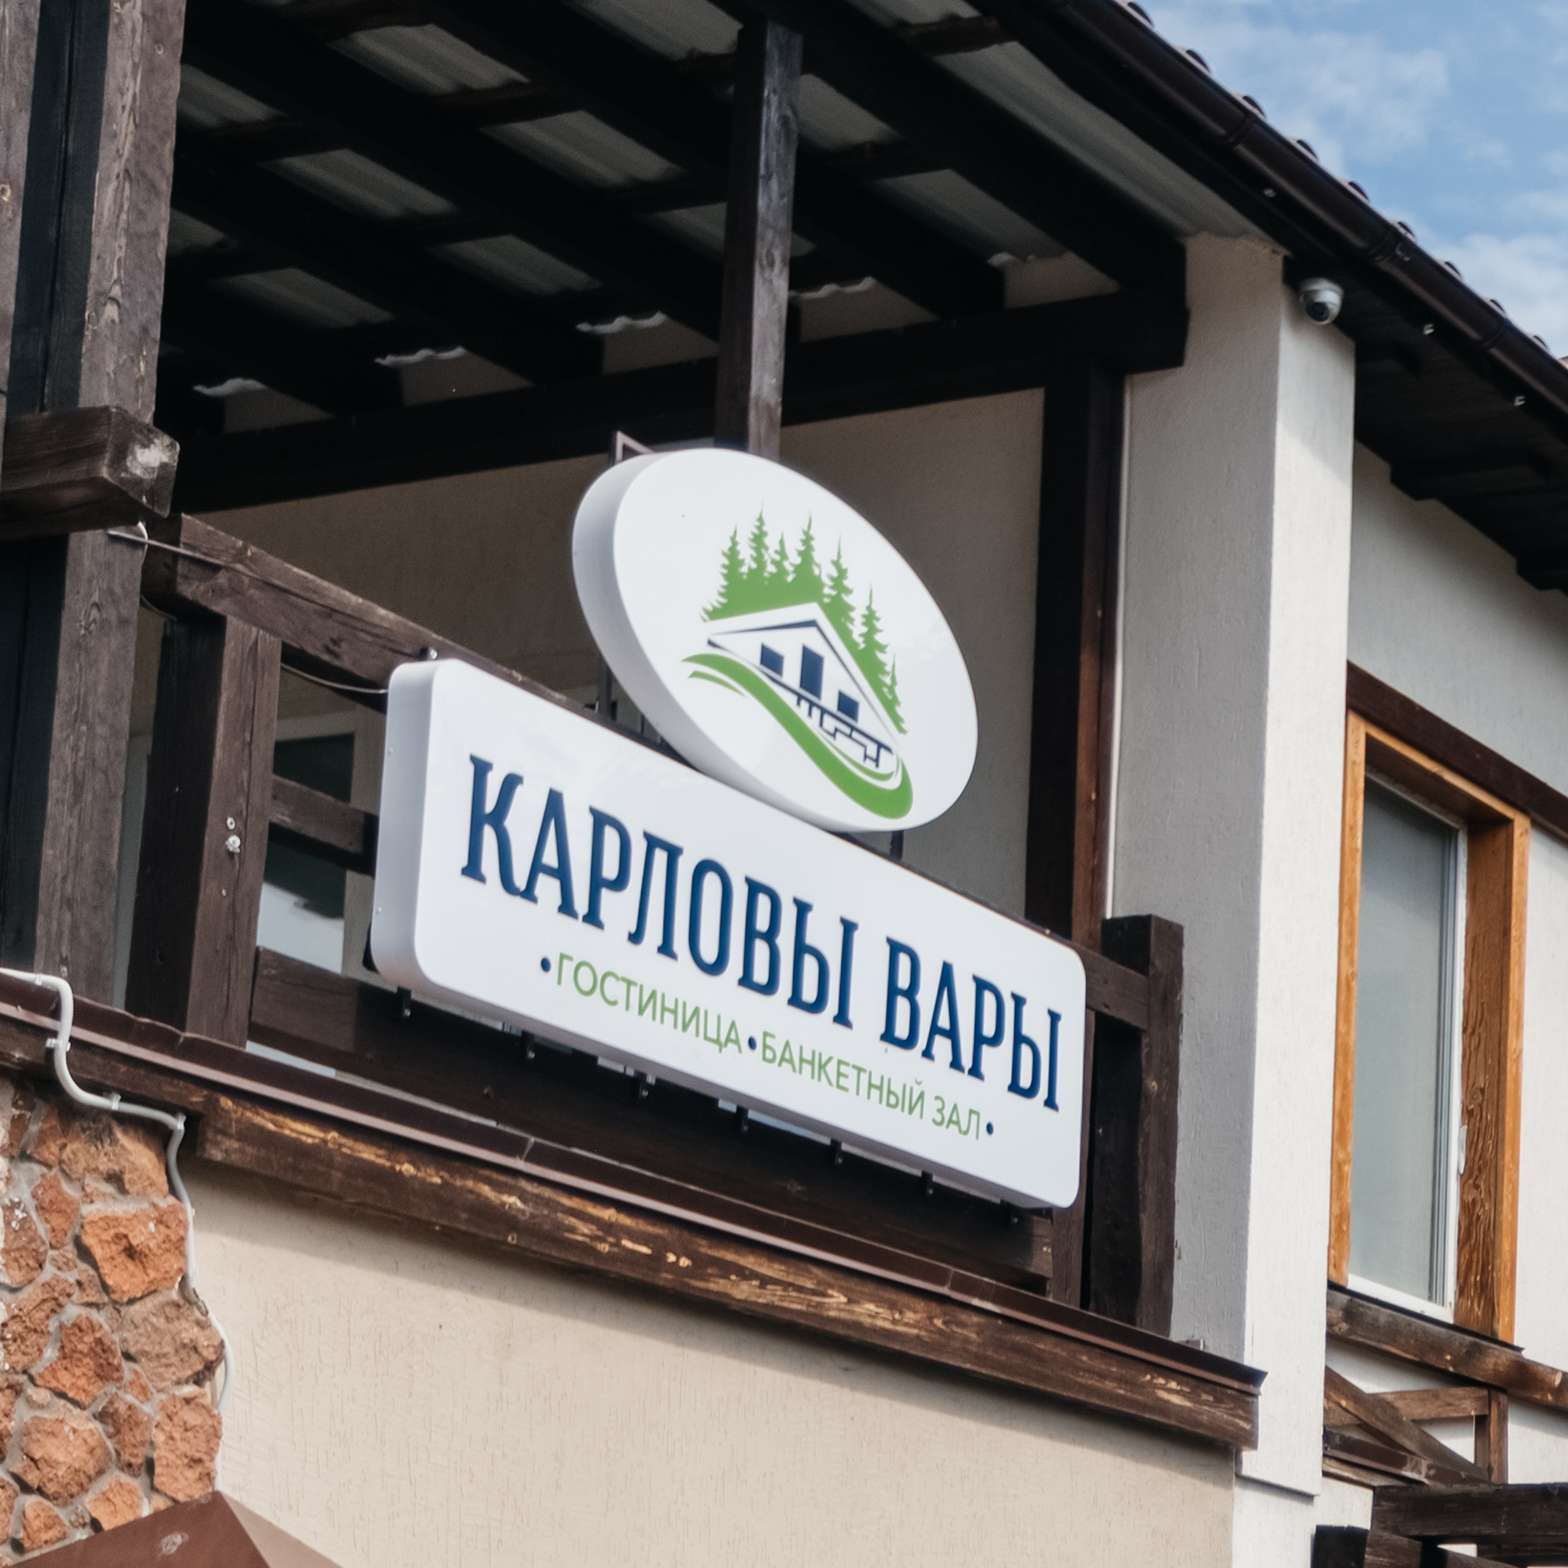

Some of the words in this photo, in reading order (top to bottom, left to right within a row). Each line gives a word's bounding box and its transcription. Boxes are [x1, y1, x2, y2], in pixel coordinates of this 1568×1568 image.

[462, 754, 859, 1029] КАРЛОВЫ
[880, 937, 1063, 1112] ВАРЫ
[556, 953, 742, 1054] ГОСТИНИЦА
[760, 1032, 926, 1120] БАНКЕТНЫЙ
[932, 1095, 981, 1141] ЗАЛ
